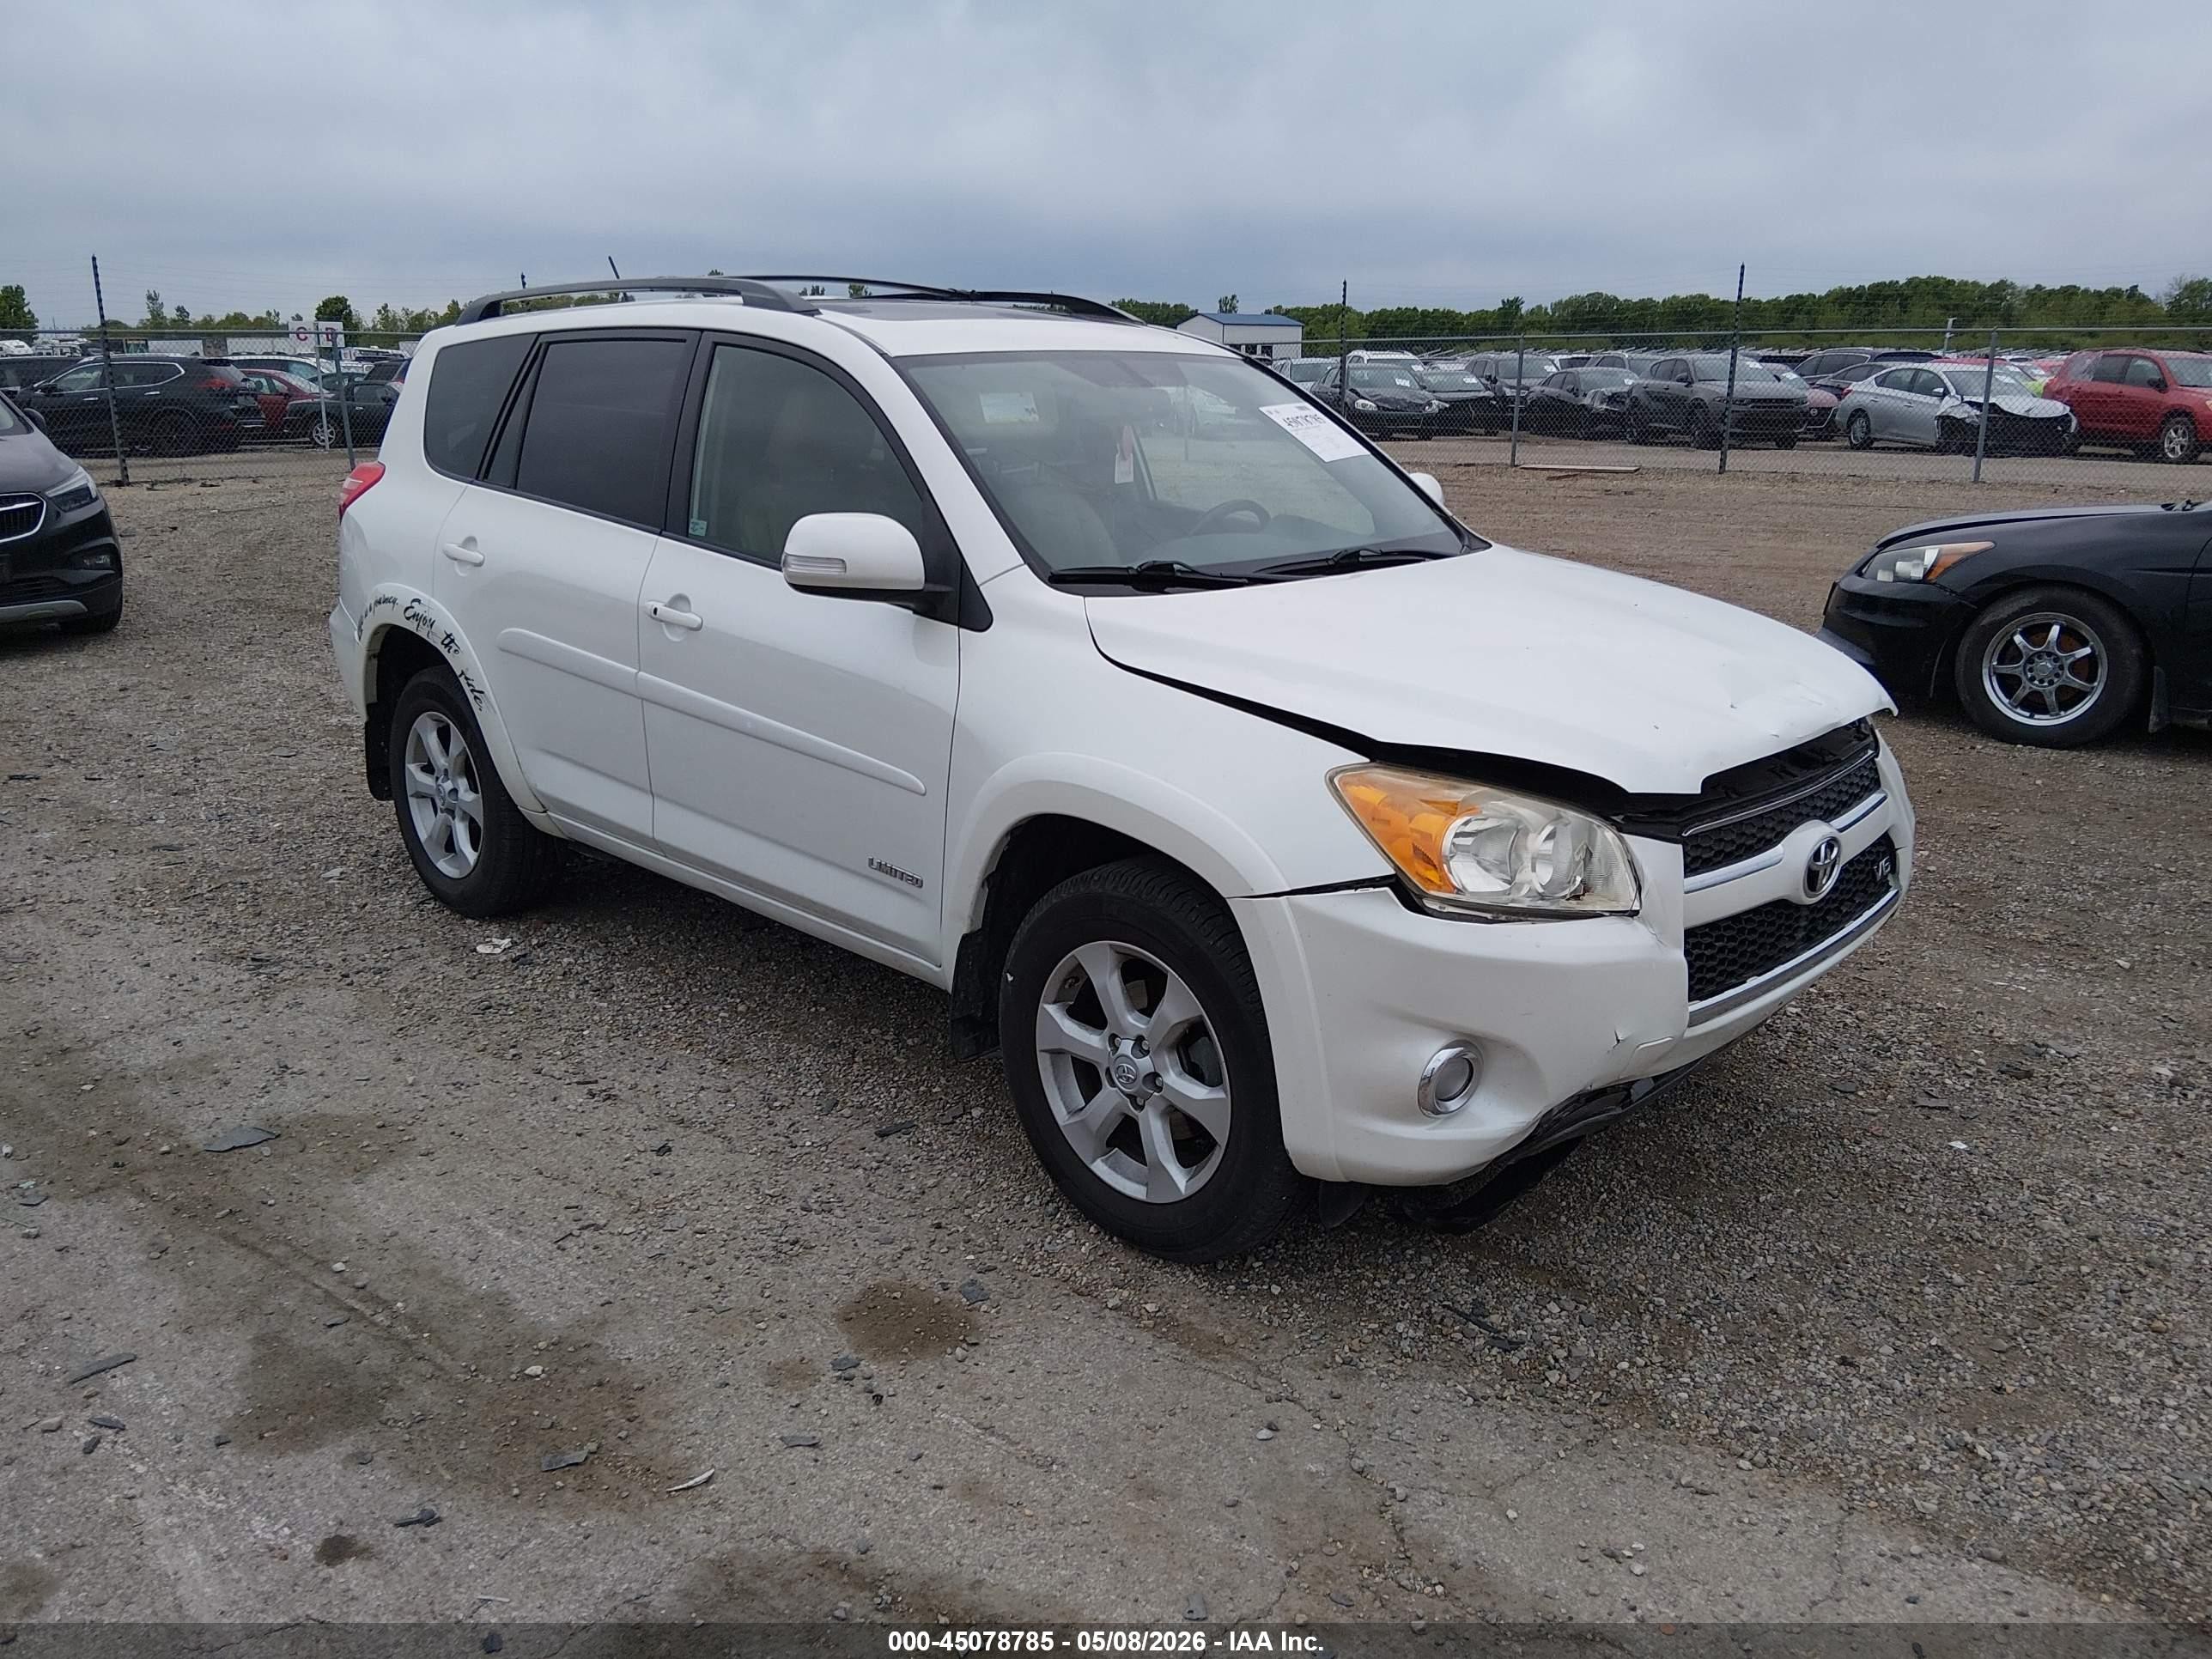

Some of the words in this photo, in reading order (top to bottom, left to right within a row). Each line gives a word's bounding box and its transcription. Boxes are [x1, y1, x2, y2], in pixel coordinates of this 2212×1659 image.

[404, 598, 436, 634] Enjoy
[441, 629, 462, 656] the
[1873, 856, 1892, 881] V6
